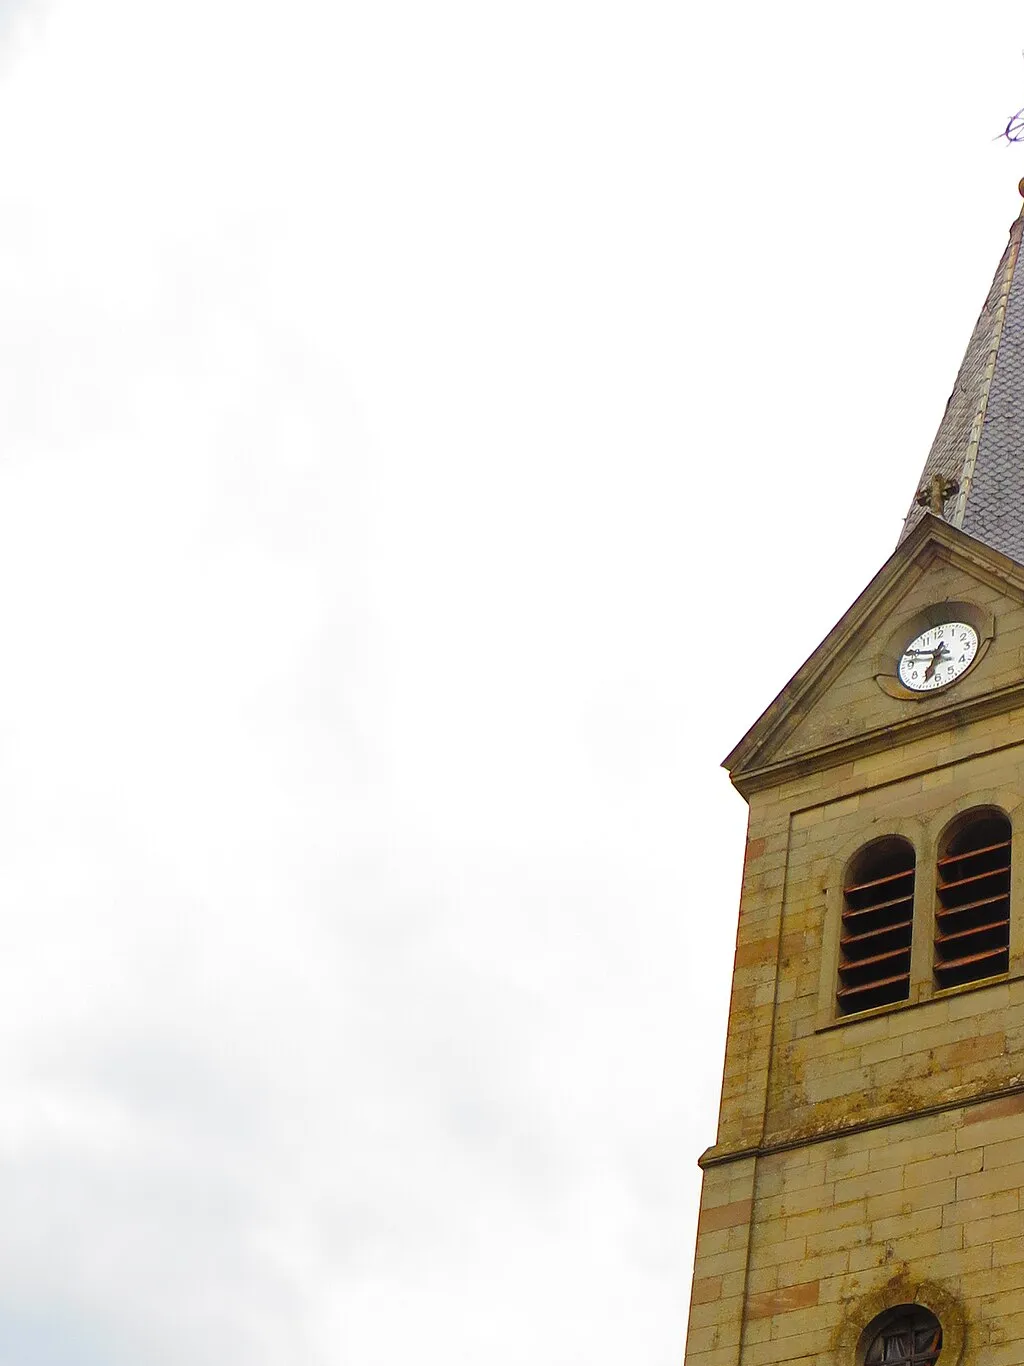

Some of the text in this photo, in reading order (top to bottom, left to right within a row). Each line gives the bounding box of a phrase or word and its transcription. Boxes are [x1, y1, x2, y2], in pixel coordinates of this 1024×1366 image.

[934, 630, 944, 639] 12
[960, 633, 966, 641] 2
[923, 637, 929, 646] 11
[964, 642, 970, 650] 3
[959, 654, 966, 663] 4
[908, 661, 914, 669] 9
[948, 665, 954, 674] 5
[912, 671, 918, 679] 8
[934, 673, 941, 682] 6
